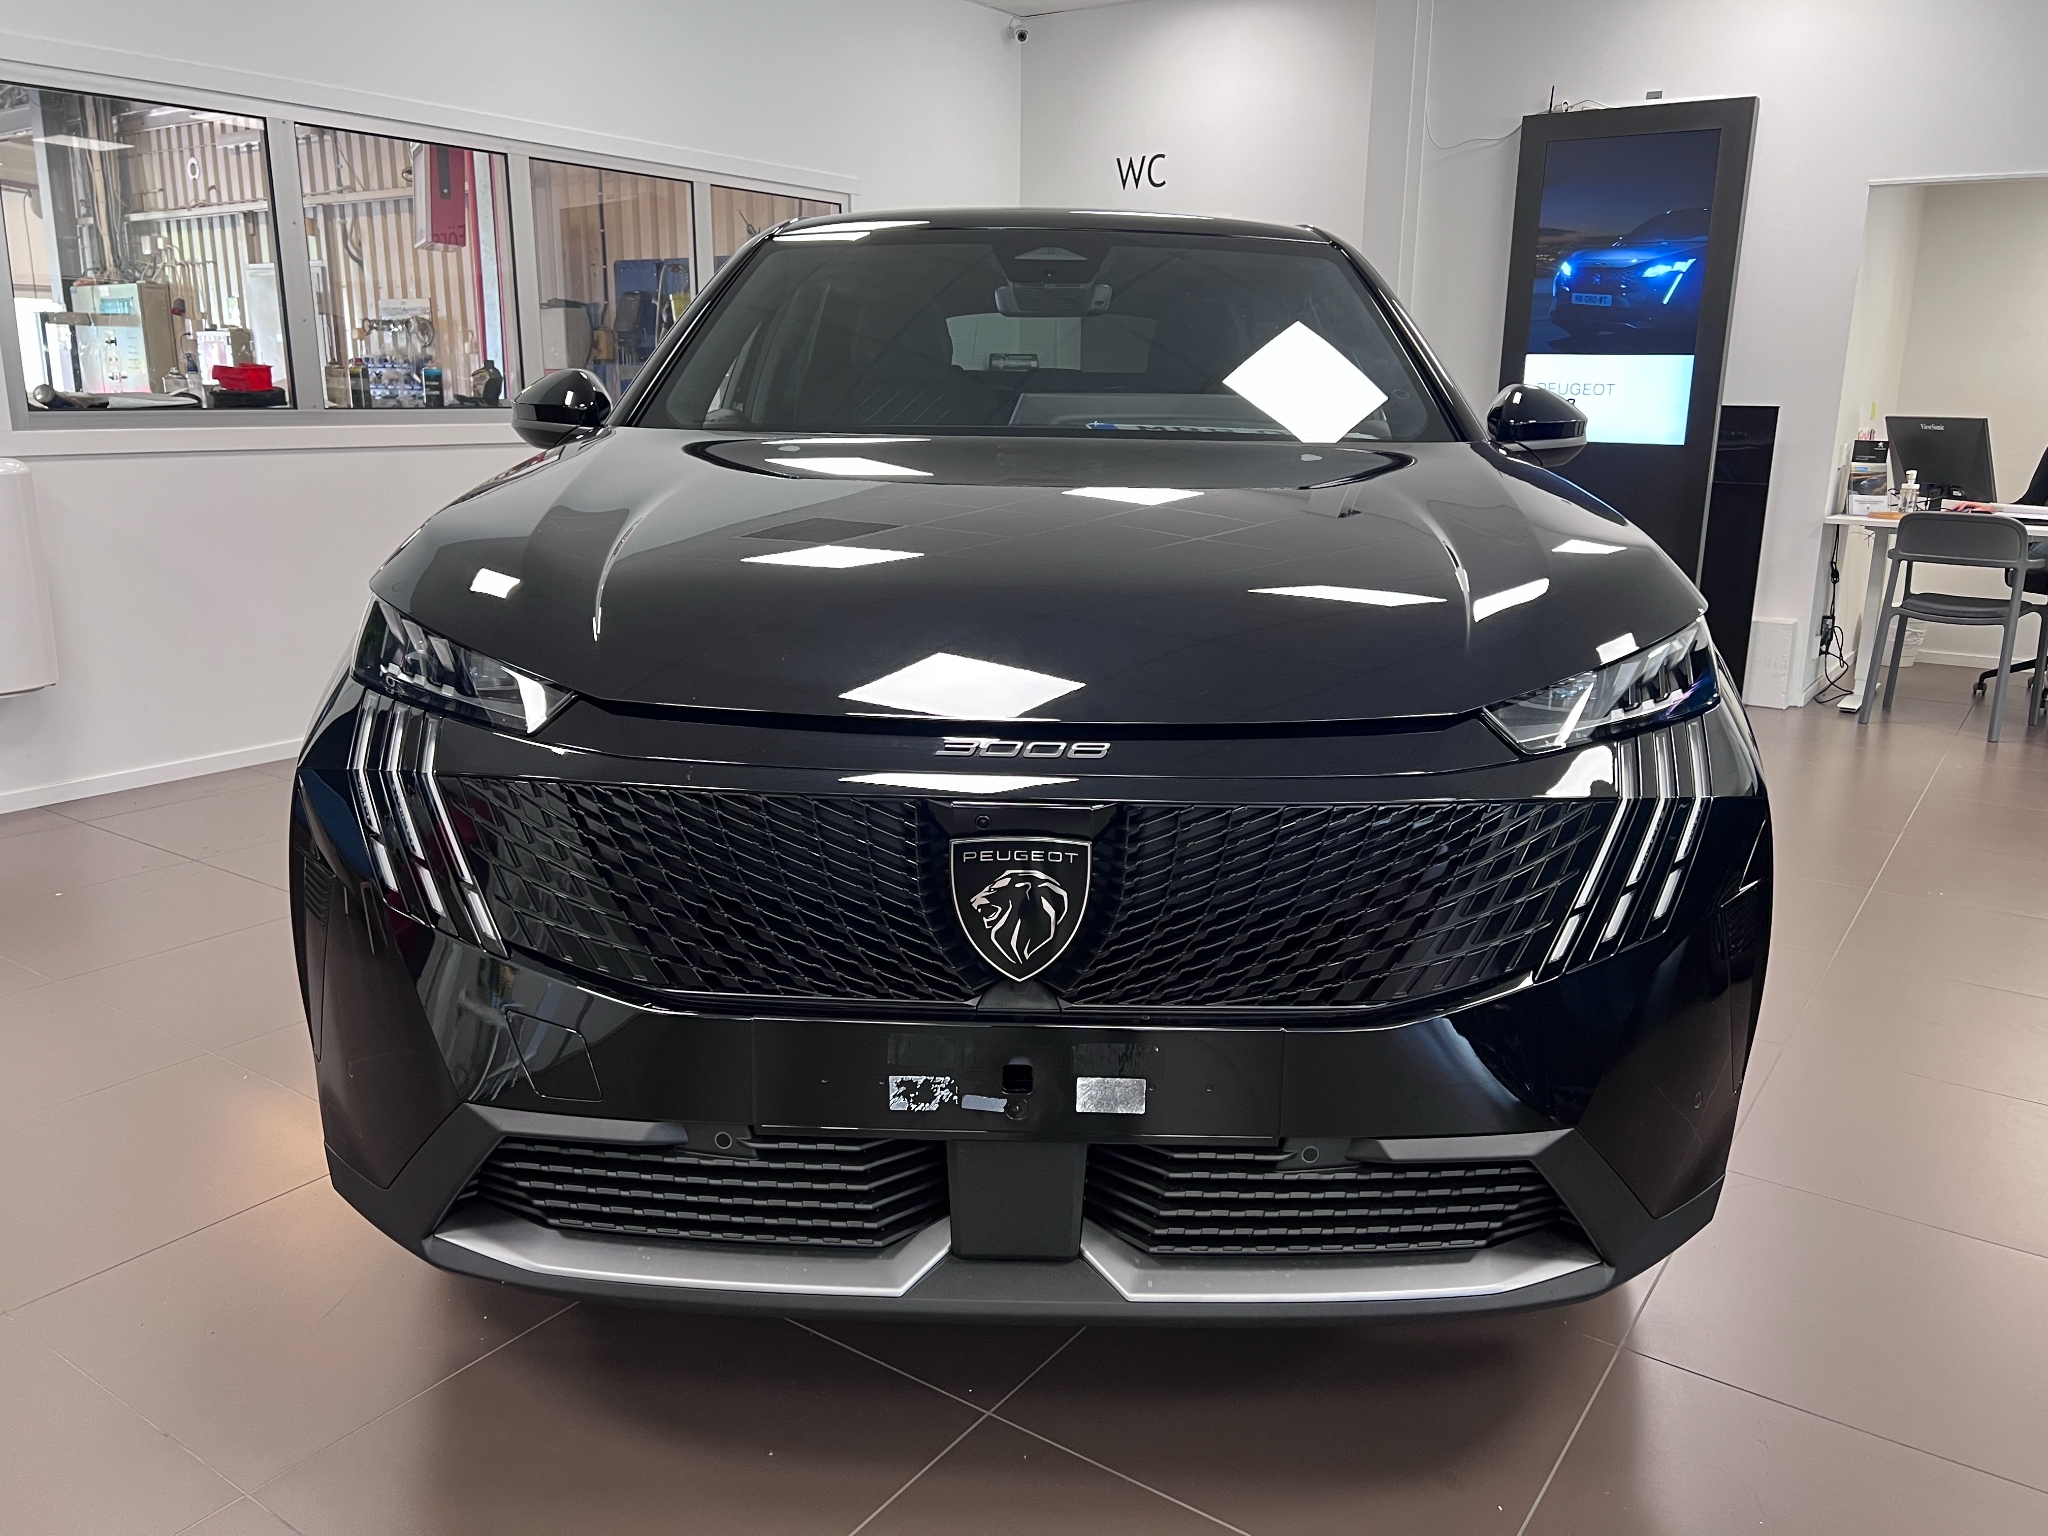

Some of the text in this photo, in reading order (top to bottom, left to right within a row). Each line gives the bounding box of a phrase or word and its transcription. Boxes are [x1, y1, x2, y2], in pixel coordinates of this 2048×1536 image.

[1116, 153, 1167, 190] WC
[934, 738, 1111, 760] 3008
[963, 850, 1079, 864] PEUGEOT
